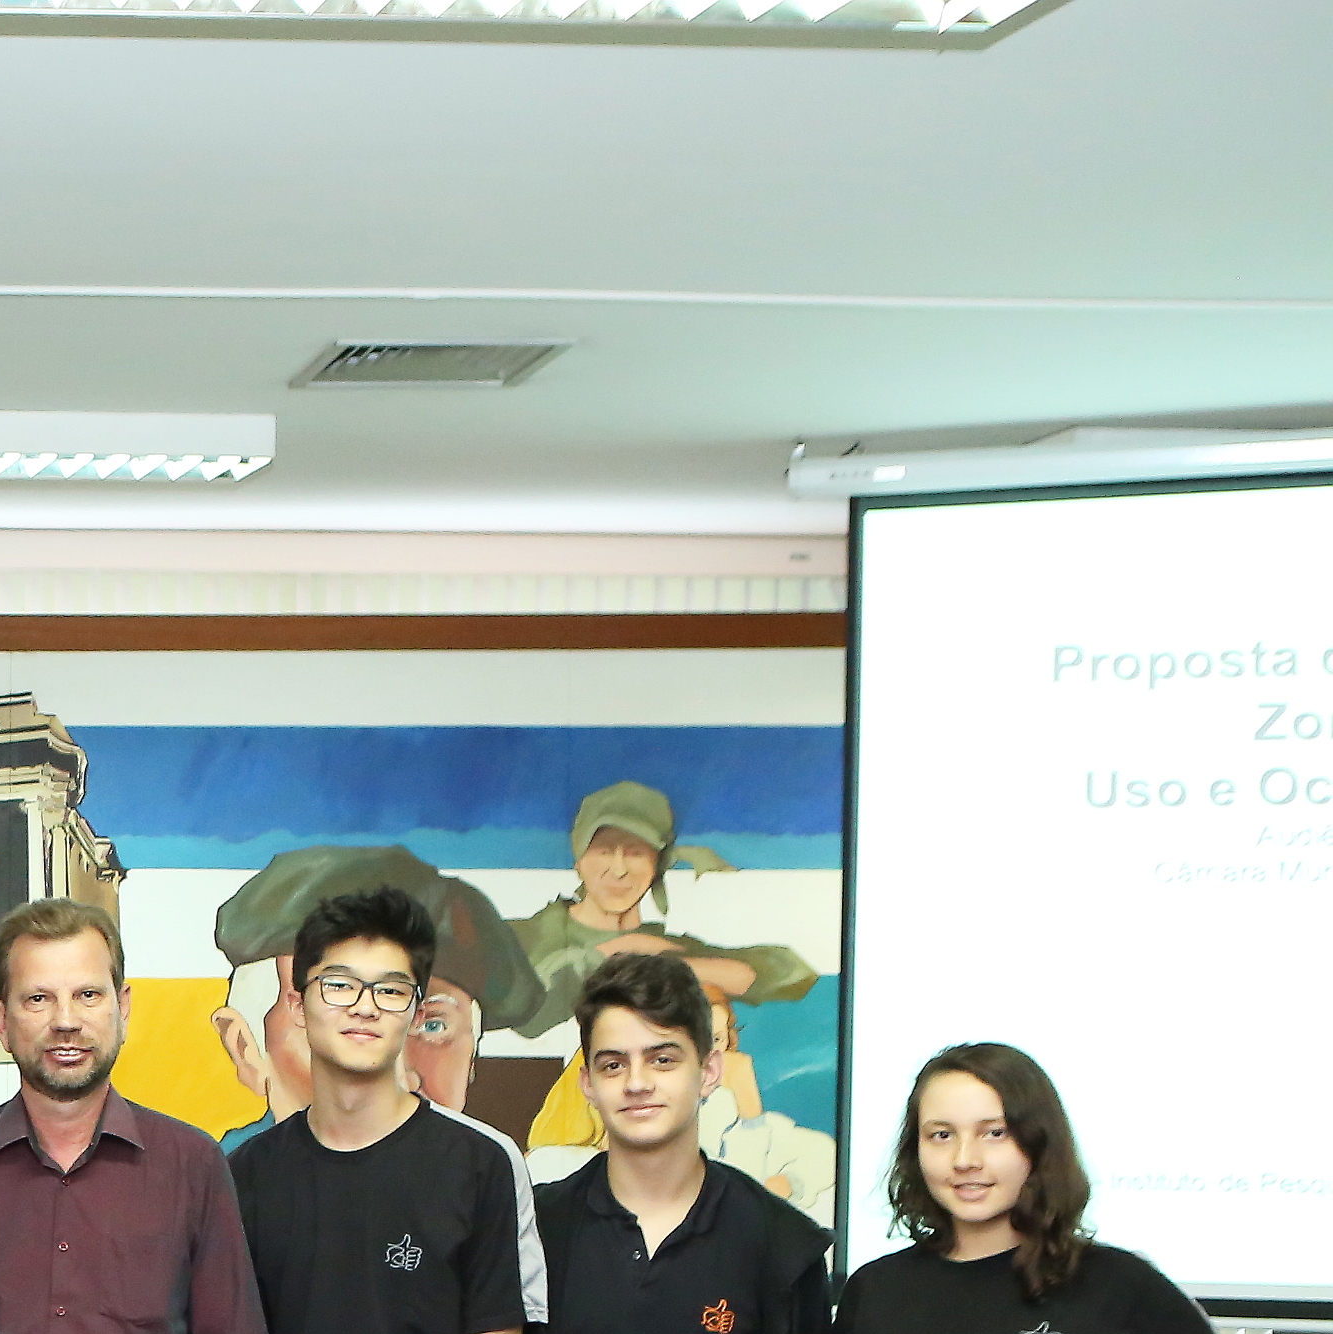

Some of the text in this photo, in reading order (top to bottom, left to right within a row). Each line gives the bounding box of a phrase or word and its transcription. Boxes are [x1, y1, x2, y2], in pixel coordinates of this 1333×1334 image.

[1052, 642, 1299, 690] Proposta
[1253, 703, 1333, 741] Zo
[1086, 770, 1188, 808] Uso
[1209, 778, 1237, 807] e
[1110, 1171, 1206, 1193] Instituto
[1218, 1172, 1250, 1193] de
